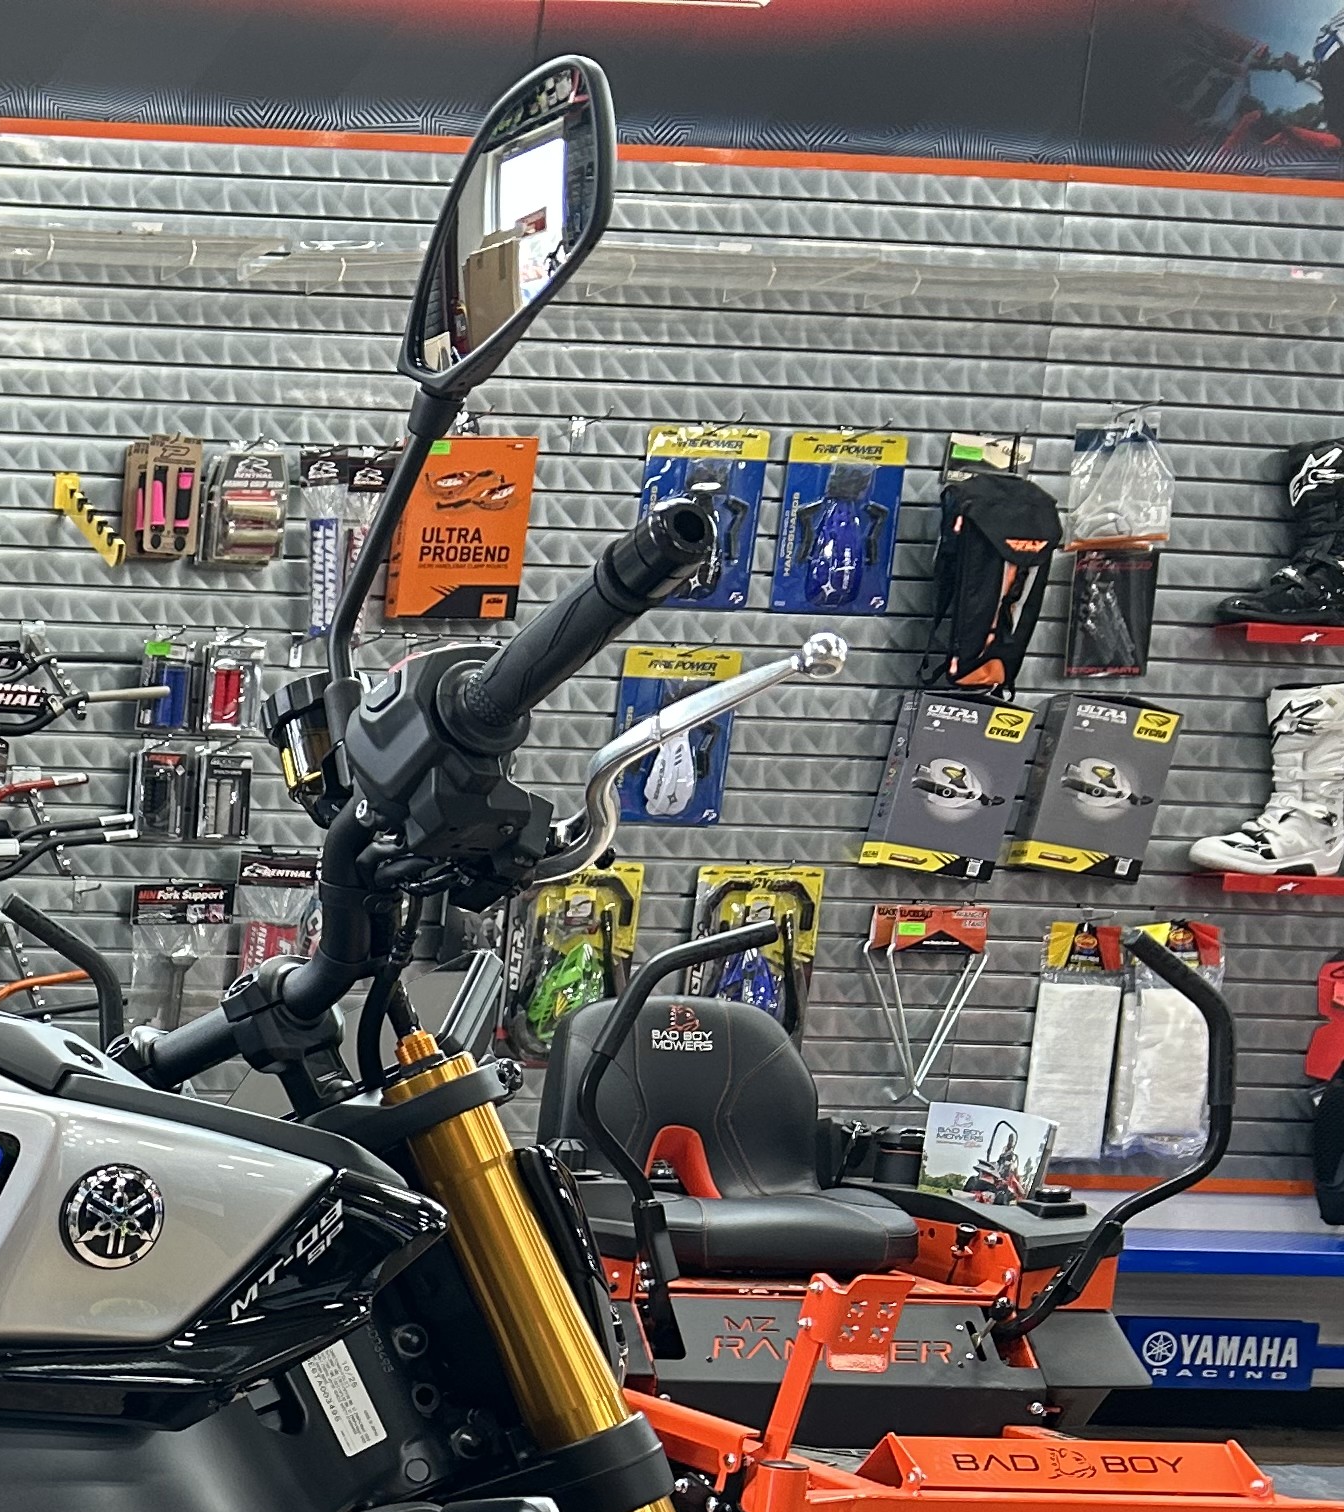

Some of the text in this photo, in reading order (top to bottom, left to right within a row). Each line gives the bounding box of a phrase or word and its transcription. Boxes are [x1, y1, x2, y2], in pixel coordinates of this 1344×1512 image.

[700, 438, 744, 450] POWER
[839, 444, 884, 455] POWER
[422, 527, 482, 543] ULTRA
[419, 546, 510, 562] PROBEND
[673, 661, 718, 672] POWER
[926, 704, 979, 719] ULTRA
[1076, 704, 1128, 719] ULTRA
[157, 888, 181, 900] Fork
[181, 889, 225, 903] Support
[652, 1029, 713, 1041] BAD BOY
[652, 1040, 713, 1052] MOWERS
[307, 1220, 345, 1266] SP
[230, 1198, 344, 1321] MT-09
[723, 1316, 780, 1332] MZ
[713, 1336, 953, 1364] RANER
[1180, 1334, 1299, 1369] YAMAHA
[1151, 1367, 1289, 1381] RACING
[952, 1455, 1185, 1476] BAD BOY
